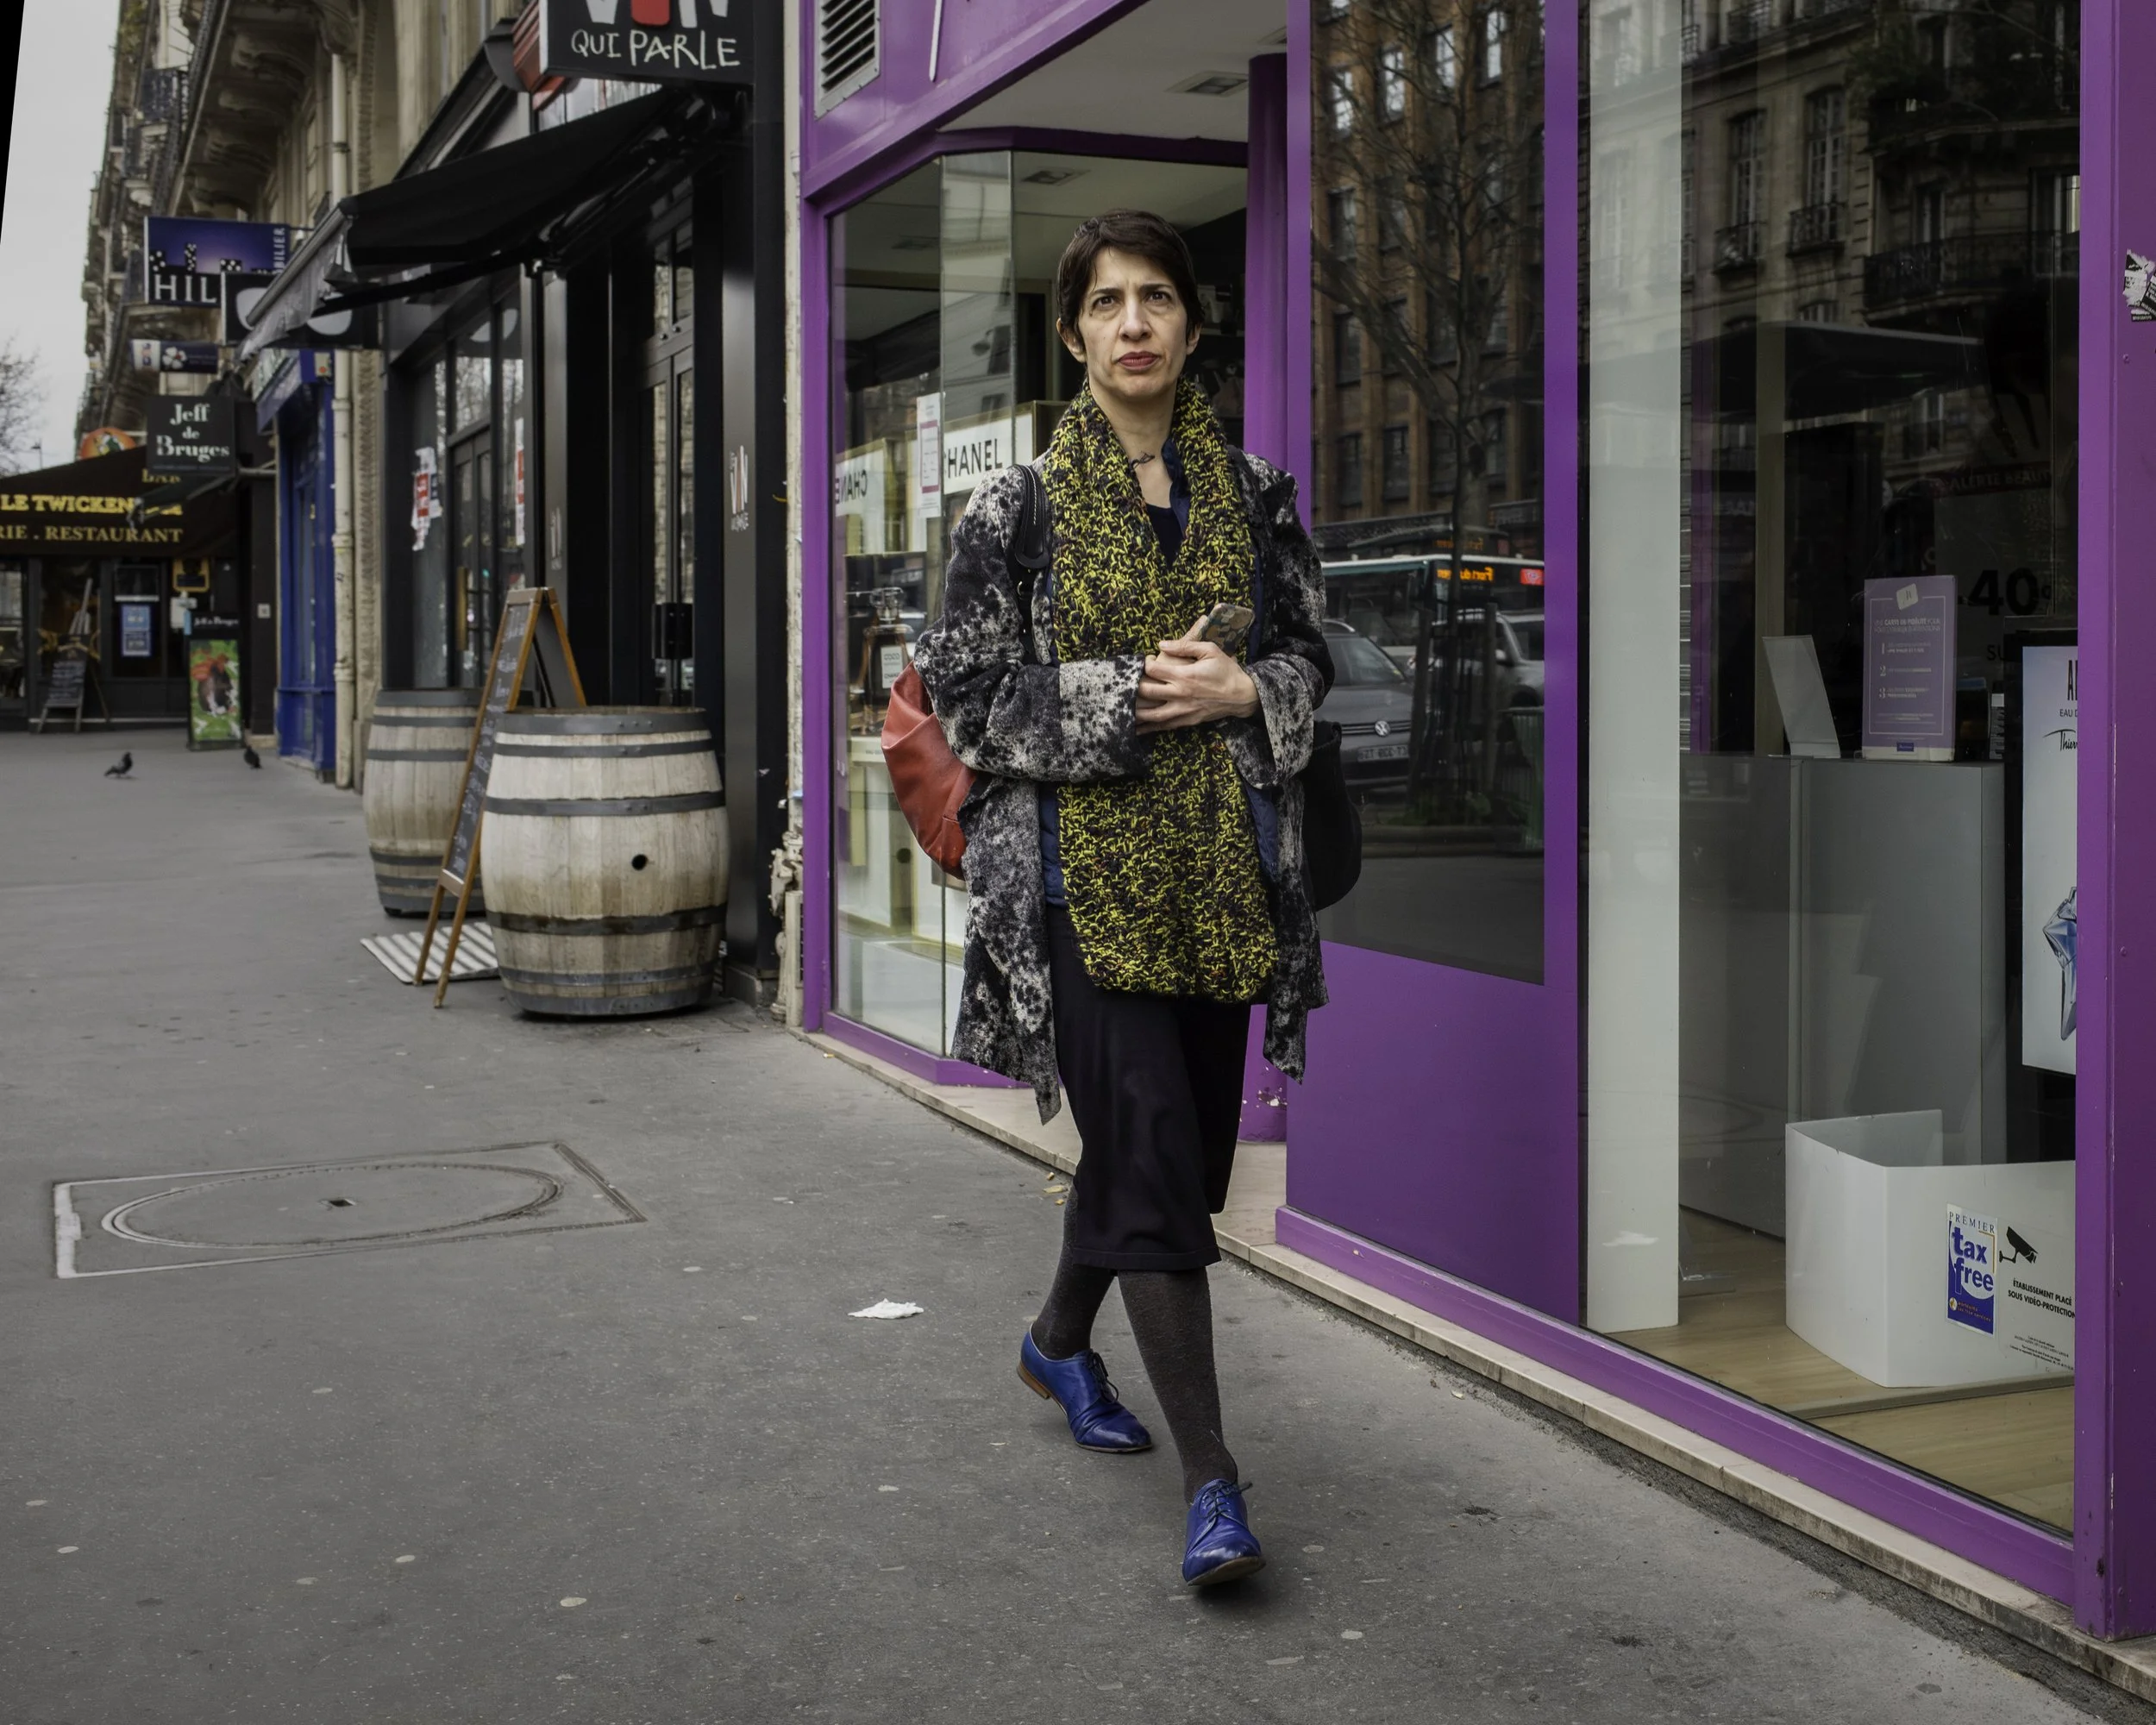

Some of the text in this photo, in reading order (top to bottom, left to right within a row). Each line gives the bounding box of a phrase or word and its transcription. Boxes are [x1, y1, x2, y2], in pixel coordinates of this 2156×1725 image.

[571, 29, 741, 71] QUI PARLE
[170, 403, 210, 425] Jeff
[182, 426, 200, 439] de
[156, 435, 230, 463] Bruges
[944, 438, 1003, 479] HANEL
[0, 494, 29, 511] LE
[45, 526, 184, 543] RESTAURANT
[2059, 709, 2072, 718] EAU
[1949, 1211, 1995, 1233] PREMIER
[1952, 1226, 1988, 1264] tax
[1954, 1257, 1994, 1295] free
[2008, 1289, 2023, 1302] SOUS
[2013, 1277, 2071, 1306] ÉTABLISSEMENT PLACÉ
